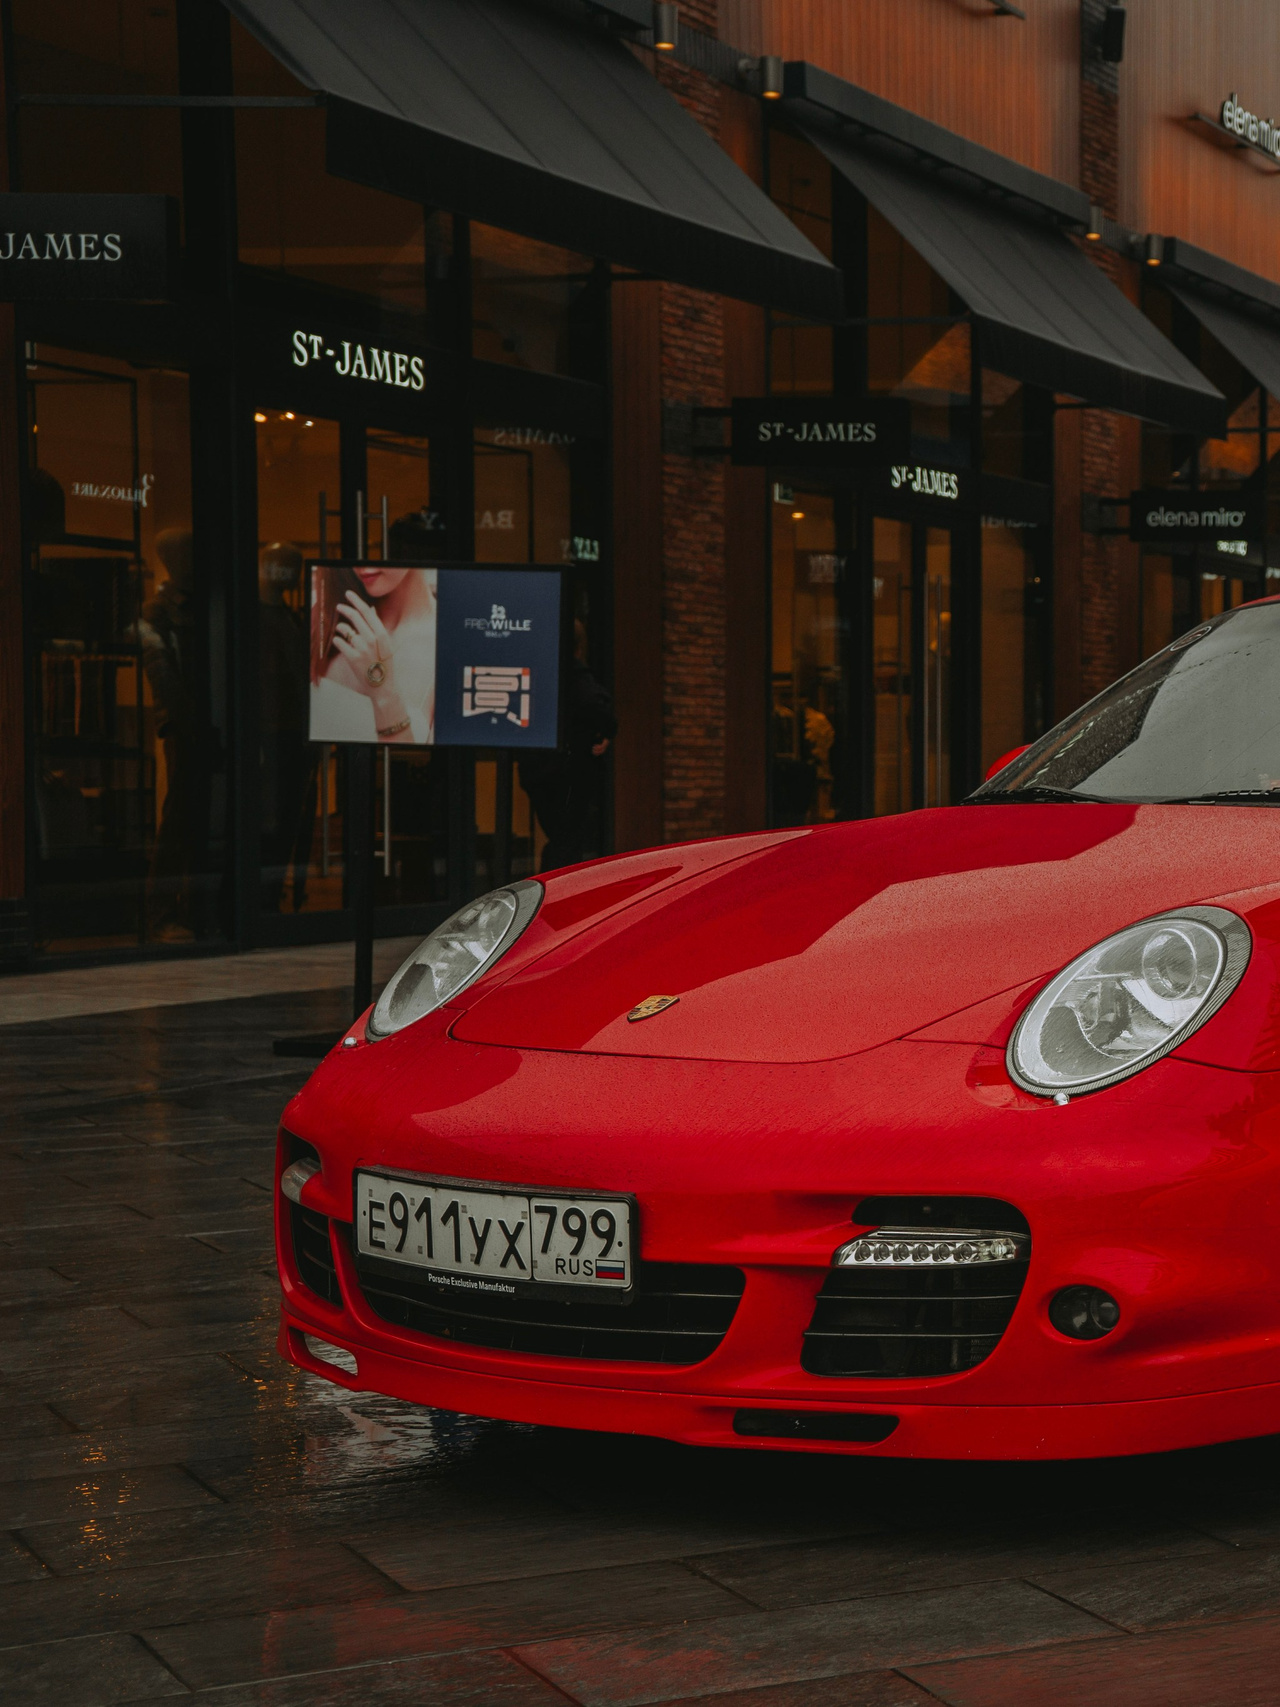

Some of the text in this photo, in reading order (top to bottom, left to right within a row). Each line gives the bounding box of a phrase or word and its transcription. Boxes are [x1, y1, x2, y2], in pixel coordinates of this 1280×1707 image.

[0, 232, 122, 262] JAMES
[292, 330, 425, 391] ST-JAMES
[758, 422, 877, 443] ST-JAMES
[891, 465, 959, 499] ST-JAMES
[534, 1205, 617, 1257] 799
[555, 1258, 594, 1276] RUS
[428, 1273, 516, 1293] Porsche Exclusive Manufaktur
